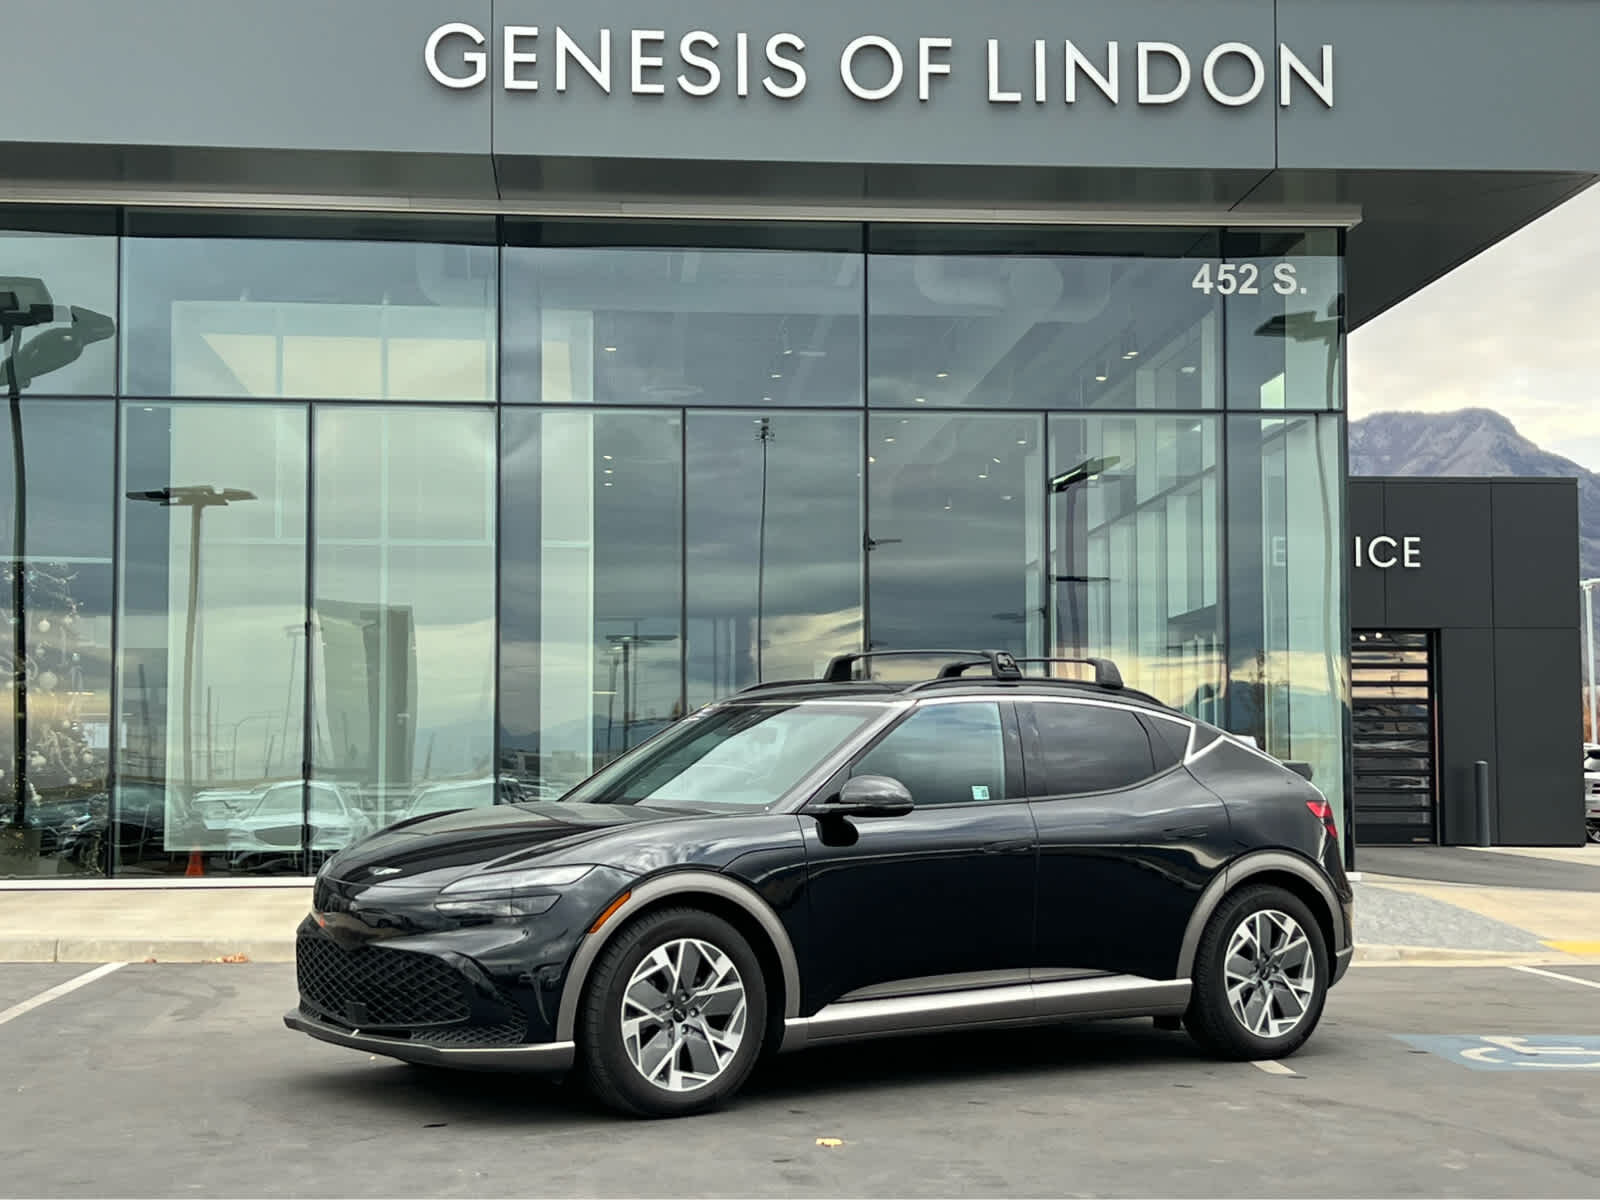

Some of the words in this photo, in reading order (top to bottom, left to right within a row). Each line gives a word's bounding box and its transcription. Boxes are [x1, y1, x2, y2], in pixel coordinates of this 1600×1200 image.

[425, 23, 806, 97] GENESIS
[841, 36, 952, 99] OF
[989, 39, 1332, 106] LINDON
[1192, 264, 1257, 294] 452
[1274, 264, 1306, 294] S.
